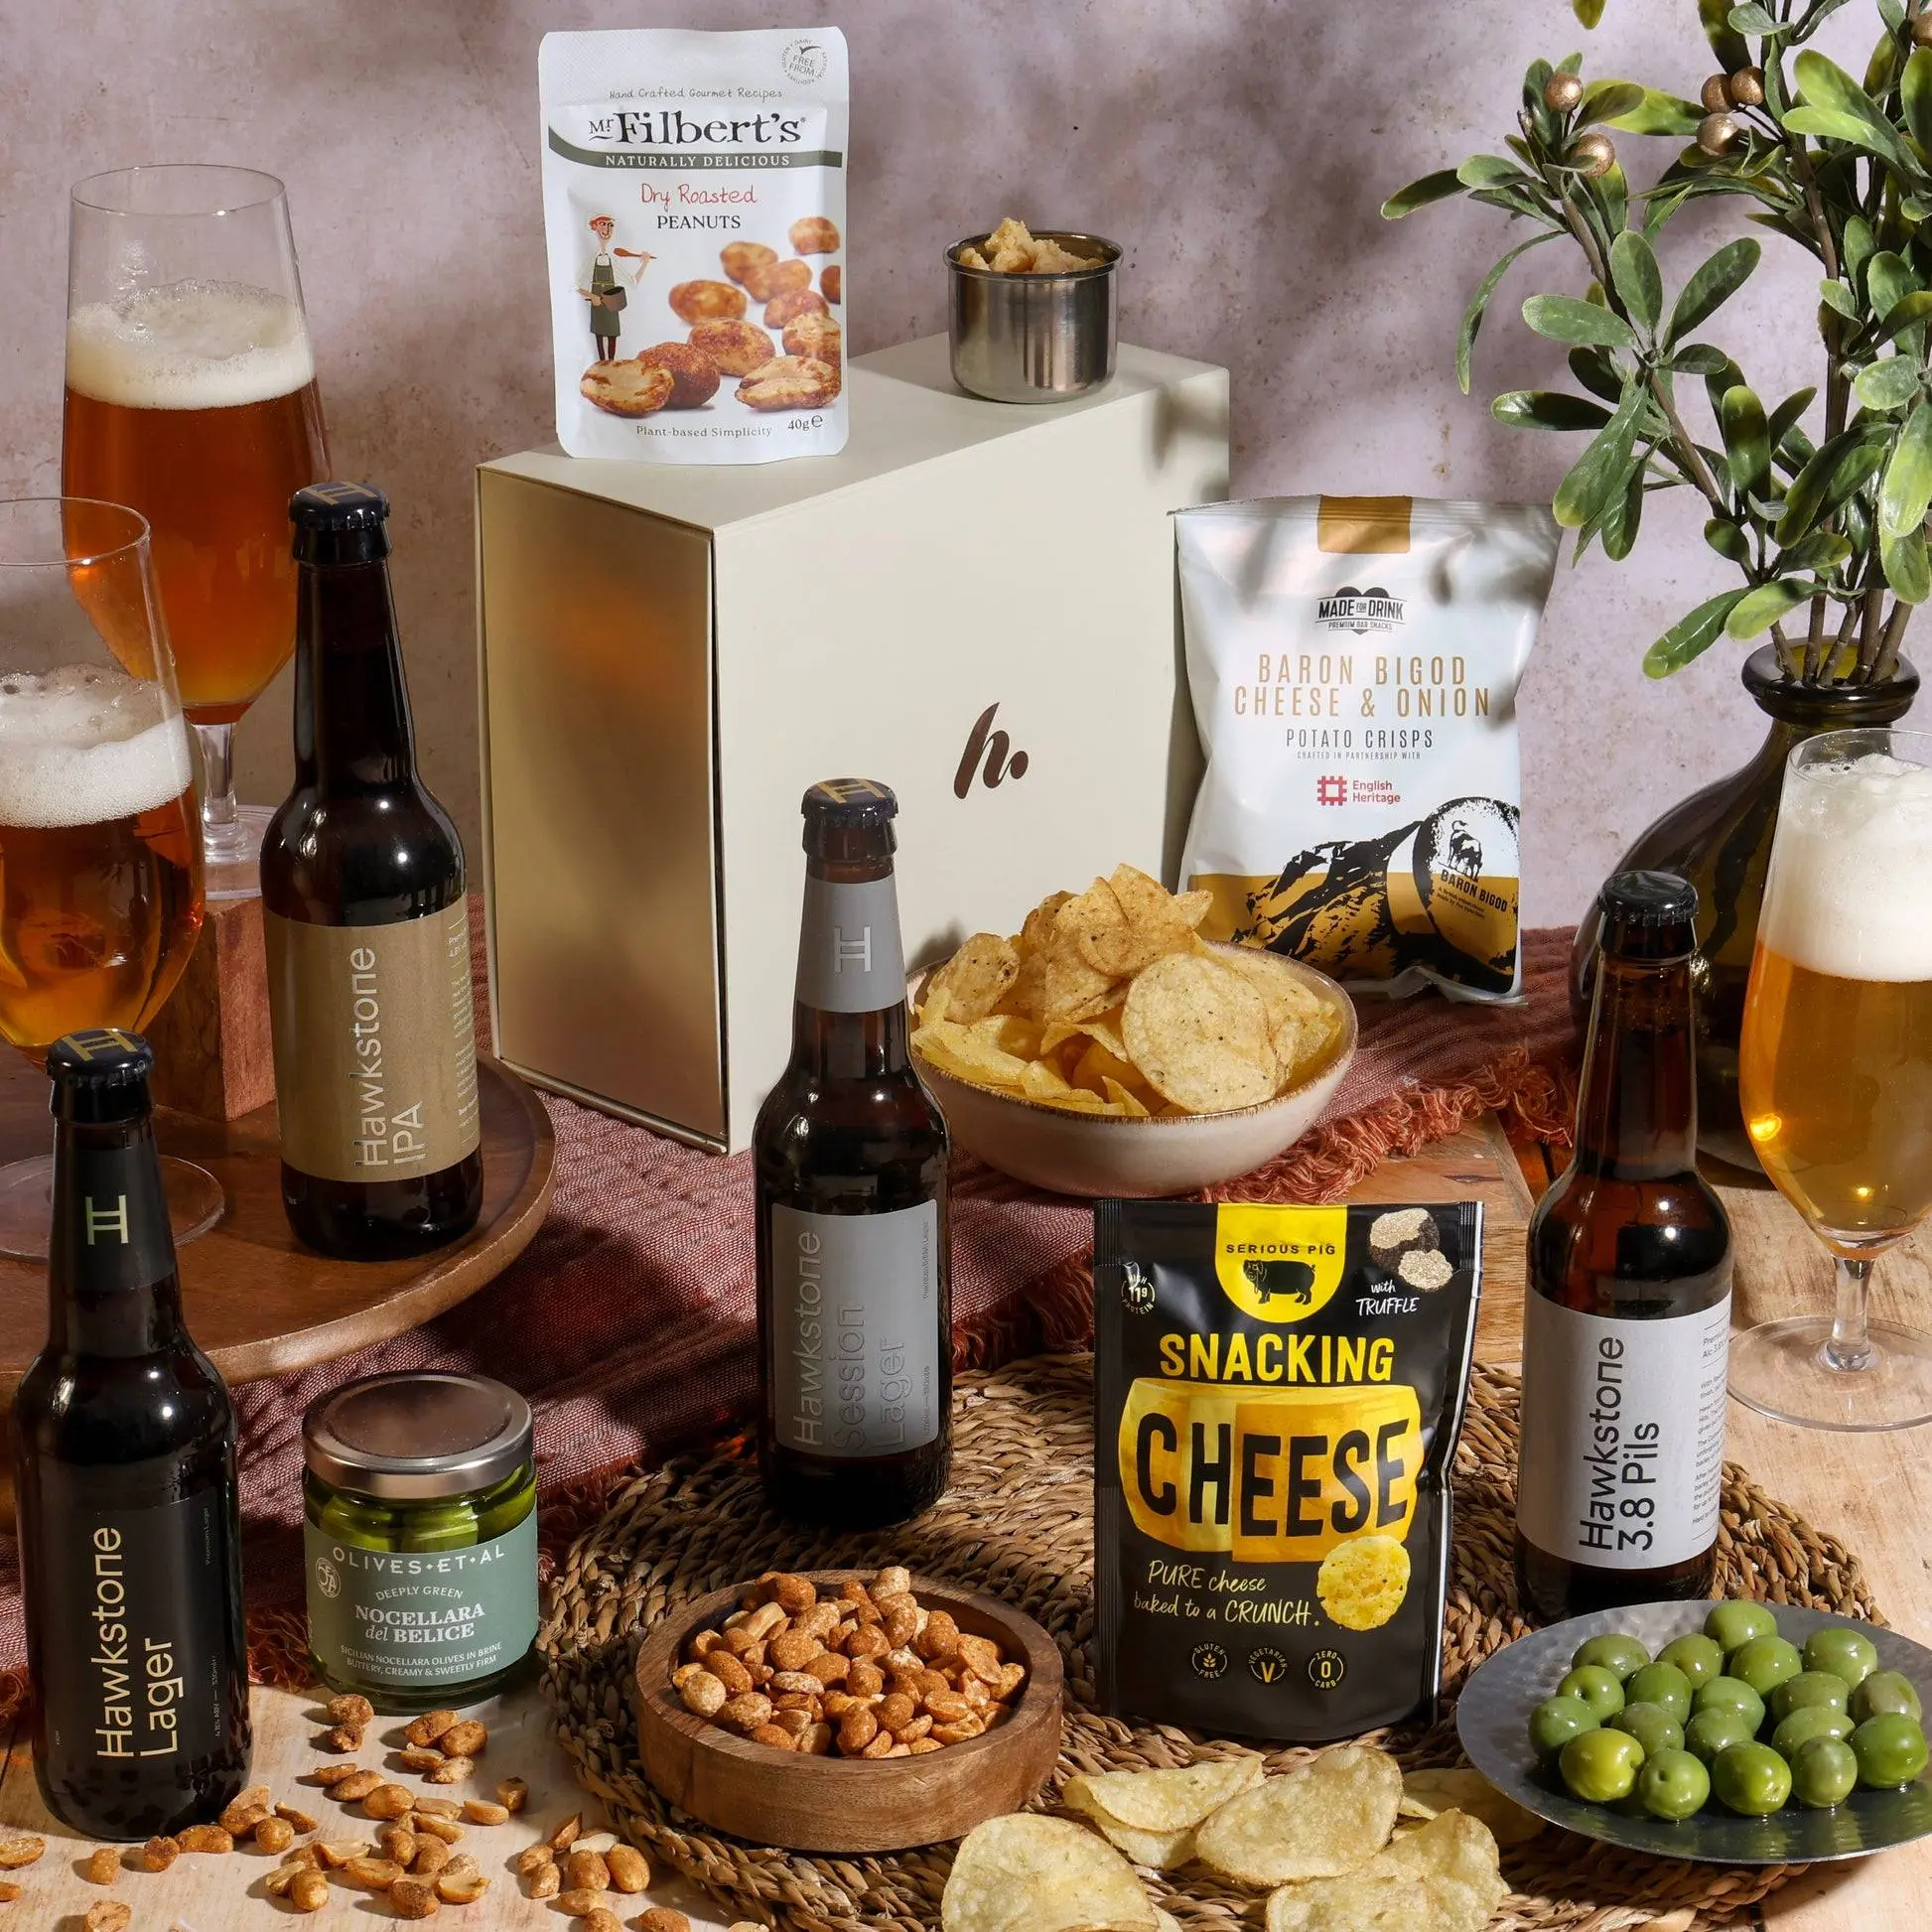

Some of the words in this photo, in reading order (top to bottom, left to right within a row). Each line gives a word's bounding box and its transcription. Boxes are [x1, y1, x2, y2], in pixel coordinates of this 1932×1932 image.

[788, 63, 815, 76] FROM
[792, 55, 815, 69] FREE
[609, 88, 634, 99] Hand
[638, 85, 684, 98] Crafted
[689, 87, 732, 98] Gourmet
[738, 86, 782, 103] Recipes
[613, 110, 801, 144] Filbert's
[605, 155, 696, 167] NATURALLY
[703, 154, 790, 167] DELICIOUS
[641, 183, 671, 211] Dry
[679, 184, 758, 205] Roasted
[656, 214, 741, 230] PEANUTS
[635, 424, 708, 438] Plant-based
[711, 426, 772, 439] Simplicity
[1318, 599, 1355, 619] MADE
[1356, 602, 1367, 612] FOR
[1368, 600, 1404, 621] DRINK
[1258, 653, 1353, 685] BARON
[1375, 655, 1466, 686] BIGOD
[1234, 685, 1339, 717] CHEESE
[1360, 687, 1376, 718] &
[1397, 687, 1489, 718] ONION
[1287, 729, 1352, 748] POTATO
[1365, 729, 1434, 749] CRISPS
[1297, 751, 1329, 759] CRAFTED
[1352, 779, 1393, 792] English
[1352, 791, 1401, 805] Heritage
[1441, 869, 1478, 898] BARON
[1478, 888, 1508, 912] BIGOD
[348, 946, 389, 1168] Hawkstone
[391, 1100, 427, 1165] IPA
[1225, 1243, 1300, 1255] SERIOUS
[1307, 1243, 1336, 1255] PIG
[1370, 1280, 1396, 1294] with
[1355, 1297, 1420, 1316] TRUFFLE
[792, 1230, 823, 1446] Hawkstone
[1159, 1332, 1395, 1383] SNACKING
[830, 1303, 866, 1450] Session
[875, 1337, 913, 1449] Lager
[1579, 1336, 1624, 1551] Hawkstone
[1621, 1422, 1660, 1484] Pils
[1136, 1412, 1411, 1538] CHEESE
[1617, 1497, 1655, 1551] 3.8
[1148, 1559, 1204, 1588] PURE
[1208, 1570, 1267, 1593] cheese
[375, 1586, 420, 1601] DEEPLY
[422, 1586, 464, 1599] GREEN
[353, 1602, 485, 1627] NOCELLARA
[1133, 1590, 1179, 1617] baked
[1184, 1600, 1200, 1618] to
[1206, 1606, 1217, 1620] a
[1224, 1598, 1319, 1628] CRUNCH.
[90, 1526, 135, 1757] Hawkstone
[364, 1624, 389, 1642] del
[392, 1622, 475, 1644] BELICE
[340, 1644, 374, 1662] SICILIAN
[375, 1654, 430, 1666] NOCELLARA
[431, 1652, 466, 1666] OLIVES
[466, 1650, 477, 1660] IN
[478, 1641, 502, 1658] BRINE
[1193, 1642, 1226, 1656] GLUTEN
[1248, 1647, 1289, 1668] VEGETARIAN
[1314, 1650, 1337, 1661] ZERO
[345, 1656, 383, 1675] BUTTERY,
[384, 1666, 423, 1677] CREAMY
[424, 1668, 434, 1677] &
[434, 1661, 475, 1677] SWEETLY
[476, 1655, 497, 1669] FIRM
[1197, 1669, 1221, 1679] FREE
[1260, 1661, 1276, 1684] V
[1313, 1679, 1336, 1689] CARB
[139, 1637, 185, 1757] Lager
